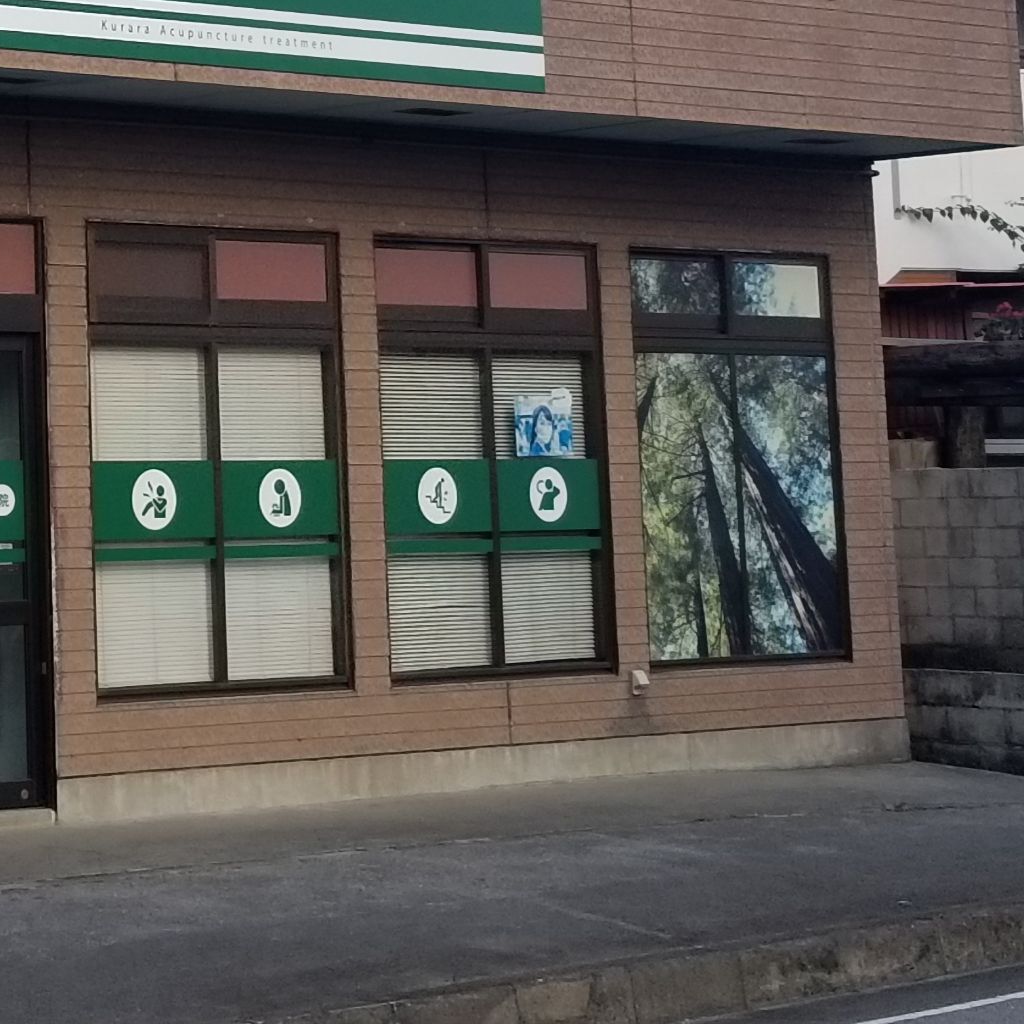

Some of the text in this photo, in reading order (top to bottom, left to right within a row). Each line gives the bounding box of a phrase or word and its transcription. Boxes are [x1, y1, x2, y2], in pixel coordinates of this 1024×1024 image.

[101, 19, 334, 51] Kurara Acupuncture treatment
